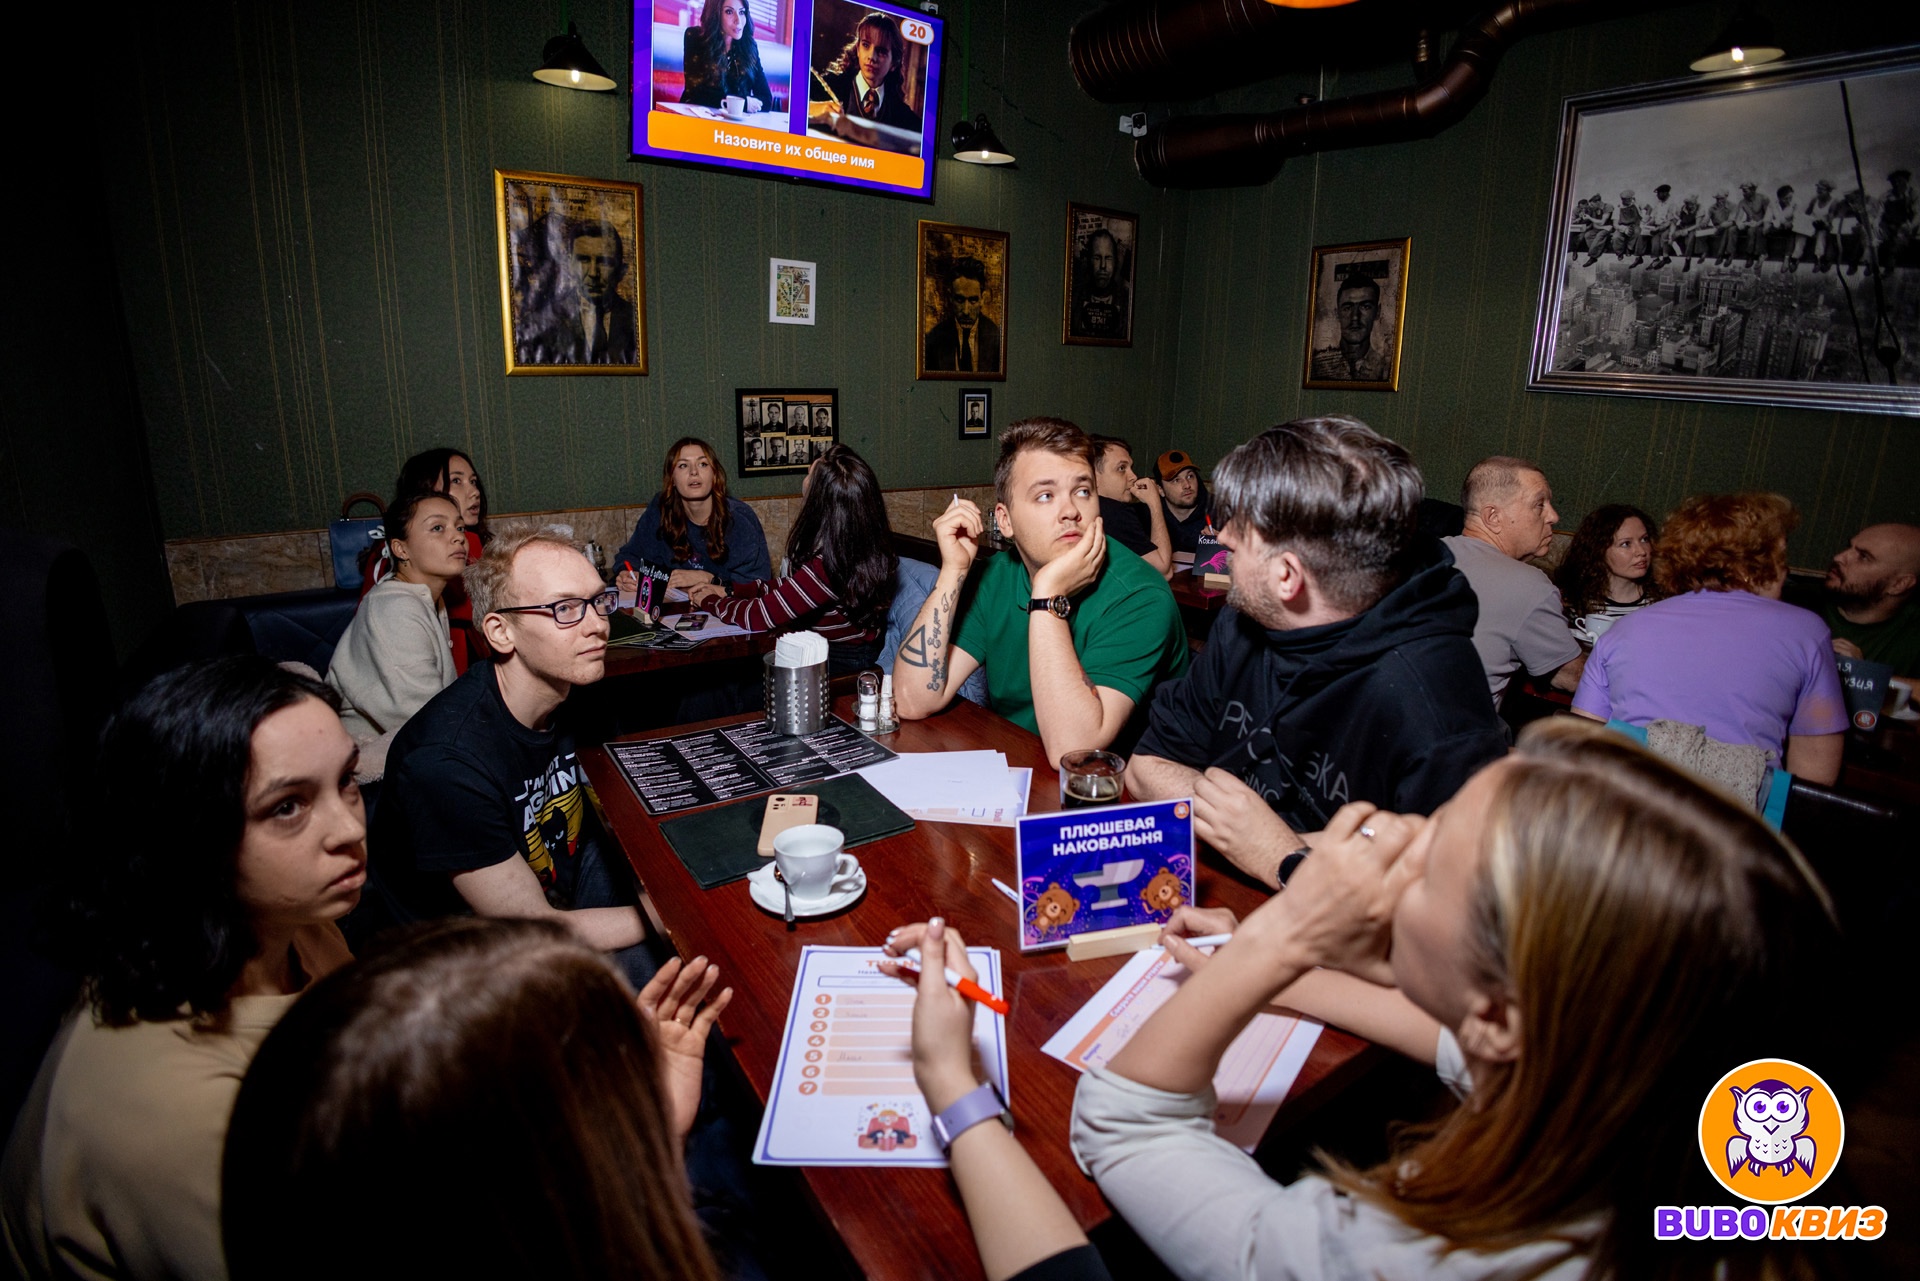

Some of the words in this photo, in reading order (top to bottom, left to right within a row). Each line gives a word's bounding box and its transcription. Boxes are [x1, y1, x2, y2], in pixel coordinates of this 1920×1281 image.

[909, 24, 926, 39] 20
[714, 129, 781, 153] Назовите
[785, 143, 801, 157] их
[805, 147, 847, 164] общее
[850, 156, 875, 169] имя
[1198, 535, 1220, 545] Кожан
[1060, 816, 1156, 840] ПЛЮШЕВАЯ
[1052, 830, 1163, 856] НАКОВАЛЬНЯ
